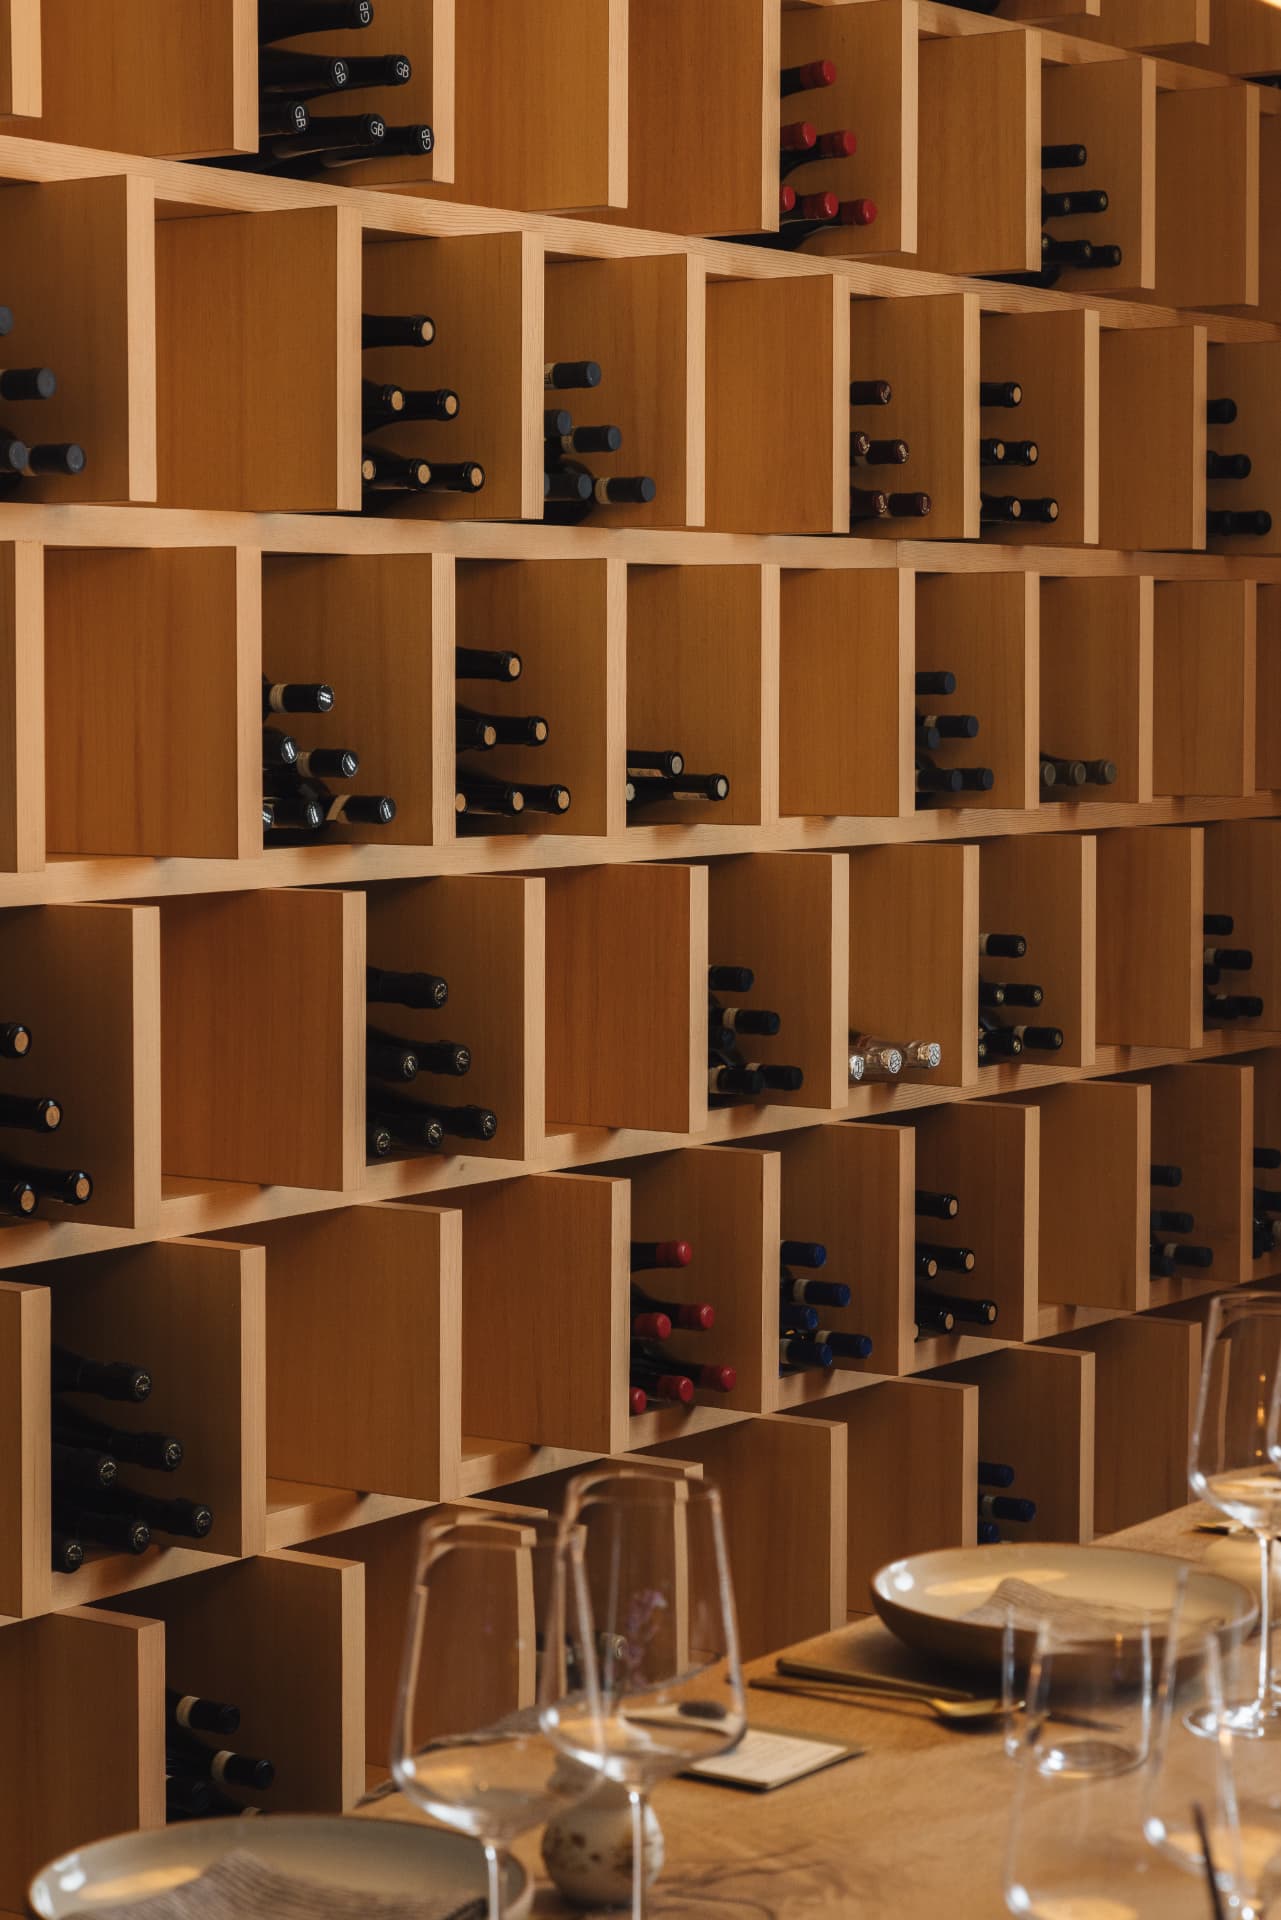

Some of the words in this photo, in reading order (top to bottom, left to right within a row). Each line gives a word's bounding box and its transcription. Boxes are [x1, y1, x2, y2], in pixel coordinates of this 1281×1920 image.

[360, 1, 370, 24] GB
[334, 61, 348, 84] GB
[396, 61, 410, 79] GB
[294, 106, 306, 128] GB
[370, 121, 385, 137] GB
[421, 128, 432, 150] GB
